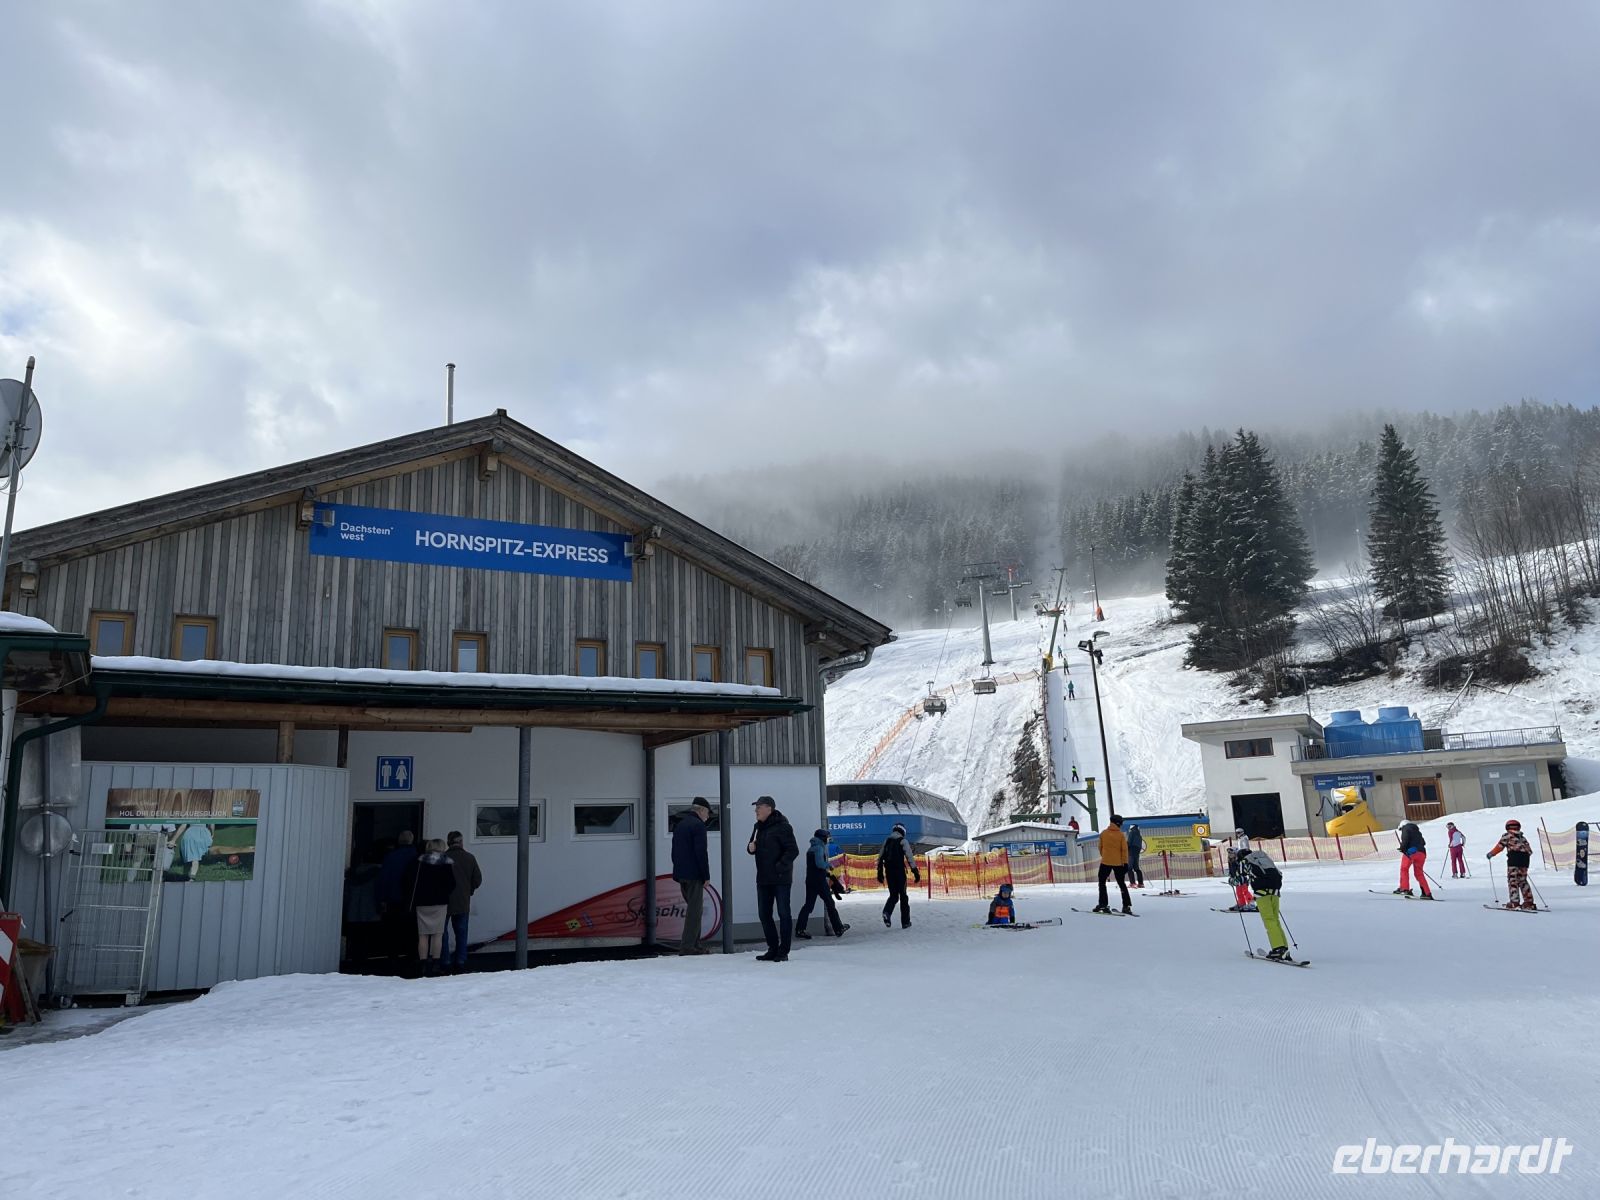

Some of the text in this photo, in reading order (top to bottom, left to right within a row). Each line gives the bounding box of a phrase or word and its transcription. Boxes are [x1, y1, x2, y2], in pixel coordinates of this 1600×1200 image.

[340, 522, 392, 536] Dachstein
[340, 531, 365, 542] west
[415, 529, 609, 565] HORNSPITZ-EXPRESS
[833, 822, 862, 830] EXPRESS
